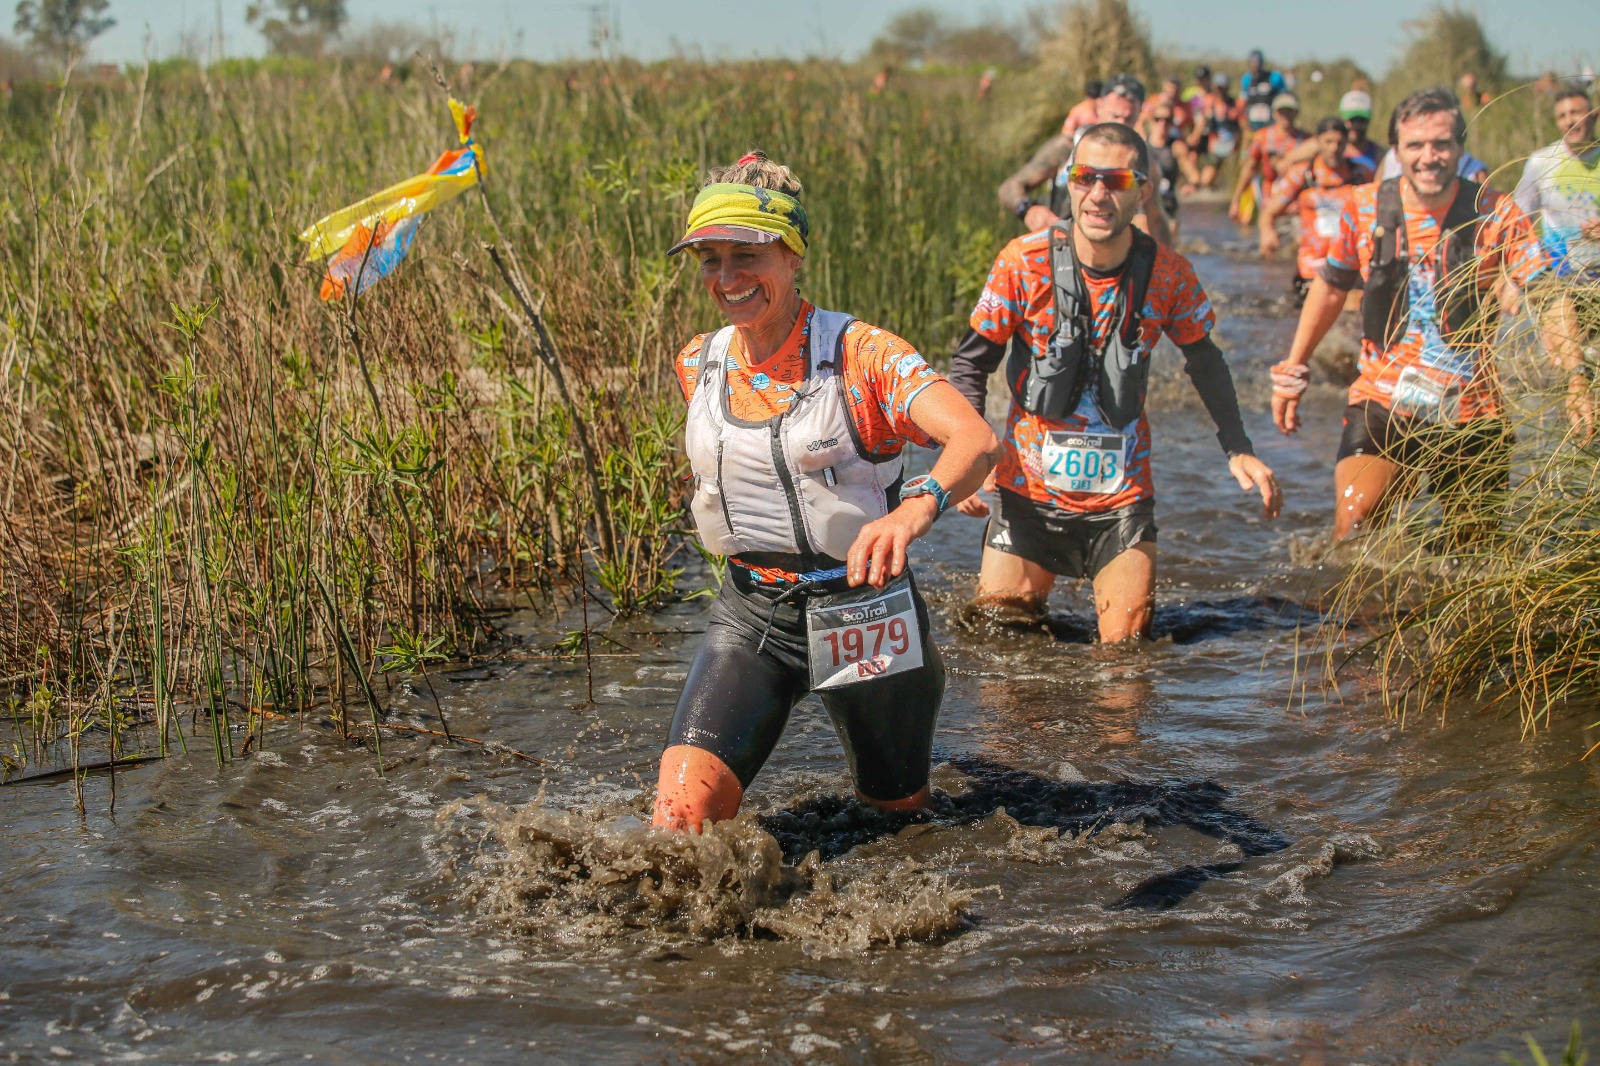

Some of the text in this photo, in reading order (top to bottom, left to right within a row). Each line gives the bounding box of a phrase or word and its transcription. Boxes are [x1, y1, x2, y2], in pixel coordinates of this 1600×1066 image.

[1067, 436, 1103, 447] ecoTrail
[1048, 449, 1118, 479] 2603
[842, 600, 888, 622] ecoTrail
[823, 617, 910, 667] 1979
